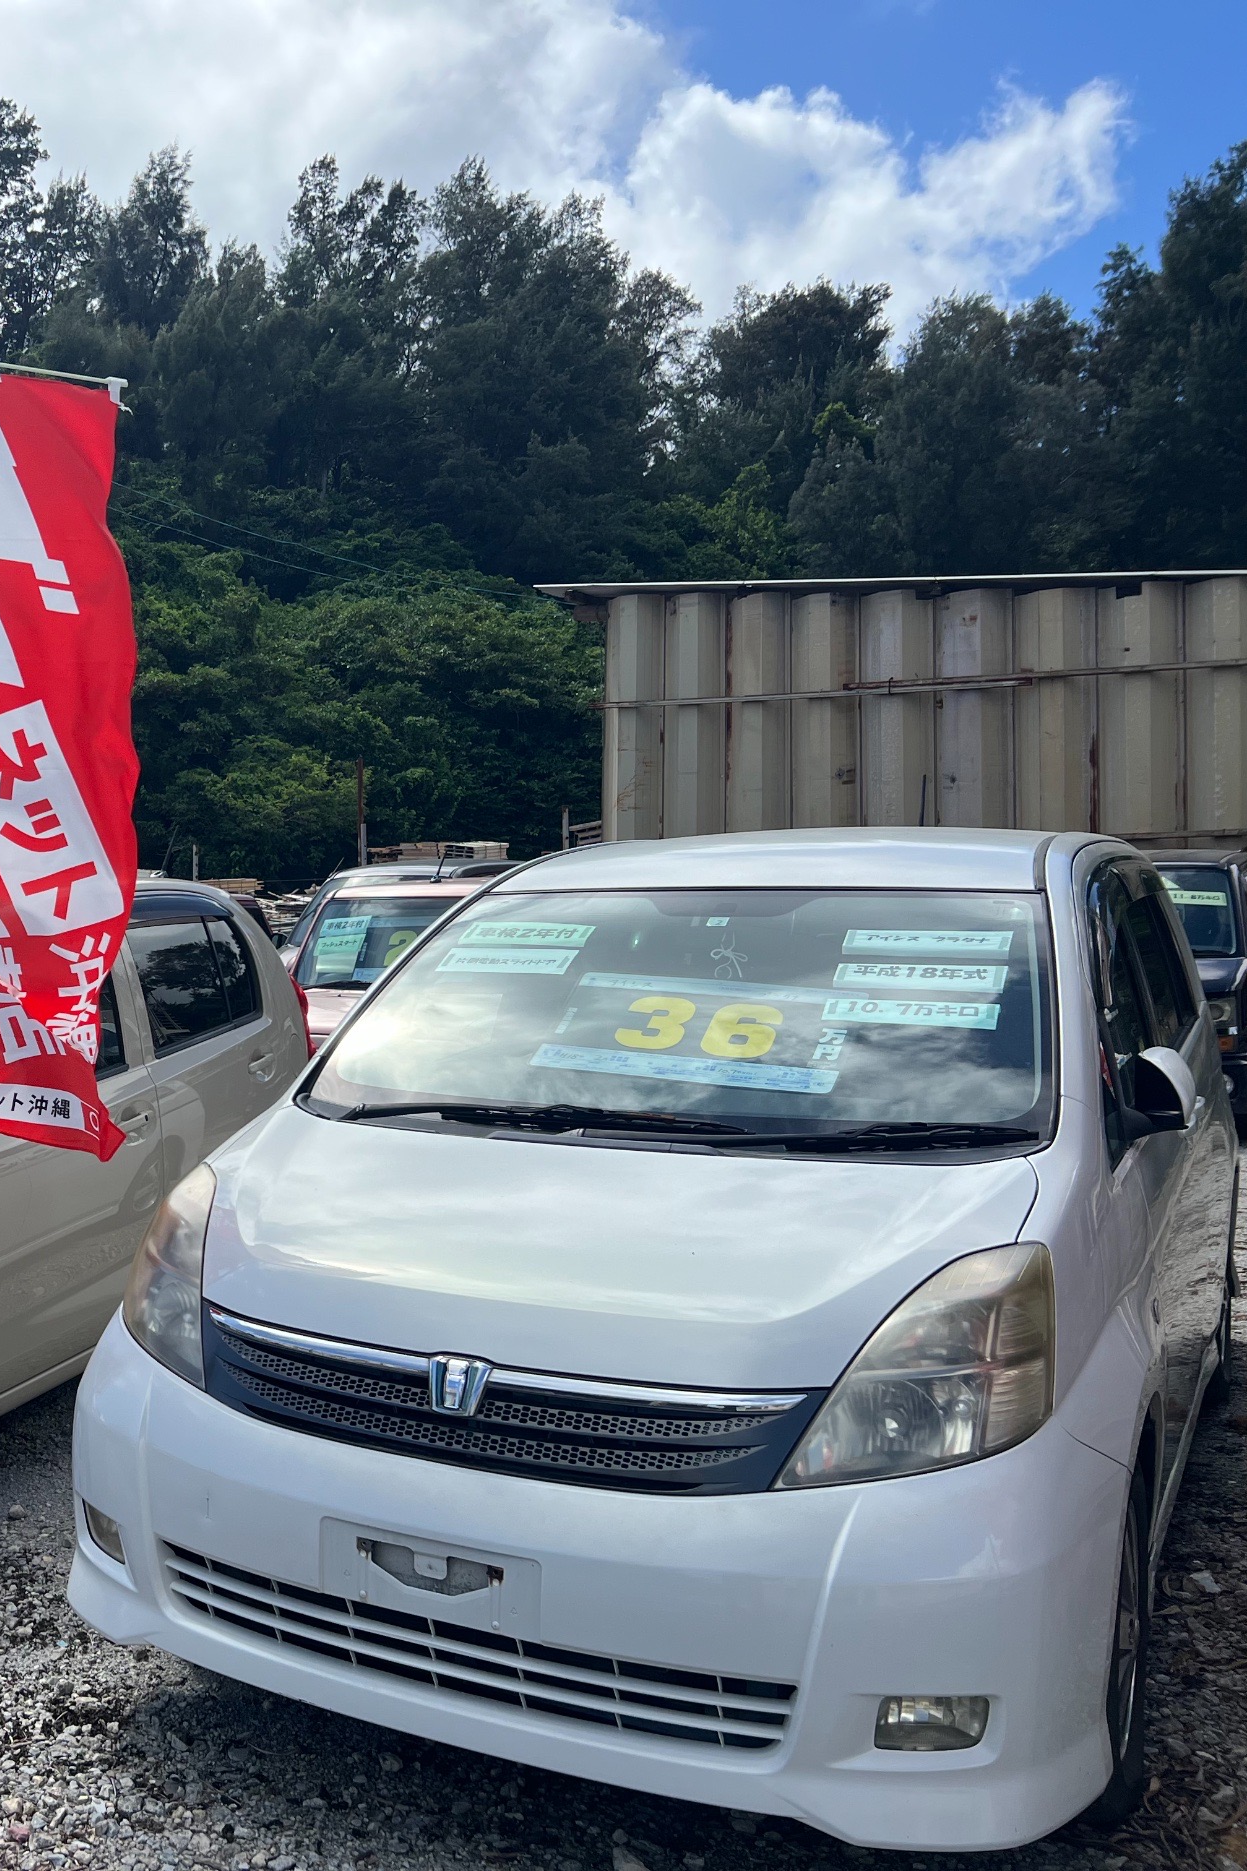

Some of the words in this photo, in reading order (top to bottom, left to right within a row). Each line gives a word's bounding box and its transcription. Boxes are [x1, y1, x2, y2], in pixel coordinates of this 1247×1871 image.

[476, 927, 579, 940] 車検2年付
[866, 934, 920, 942] アイシス
[853, 964, 989, 981] 平成18年式
[614, 996, 784, 1058] 36
[811, 1028, 848, 1061] 万円
